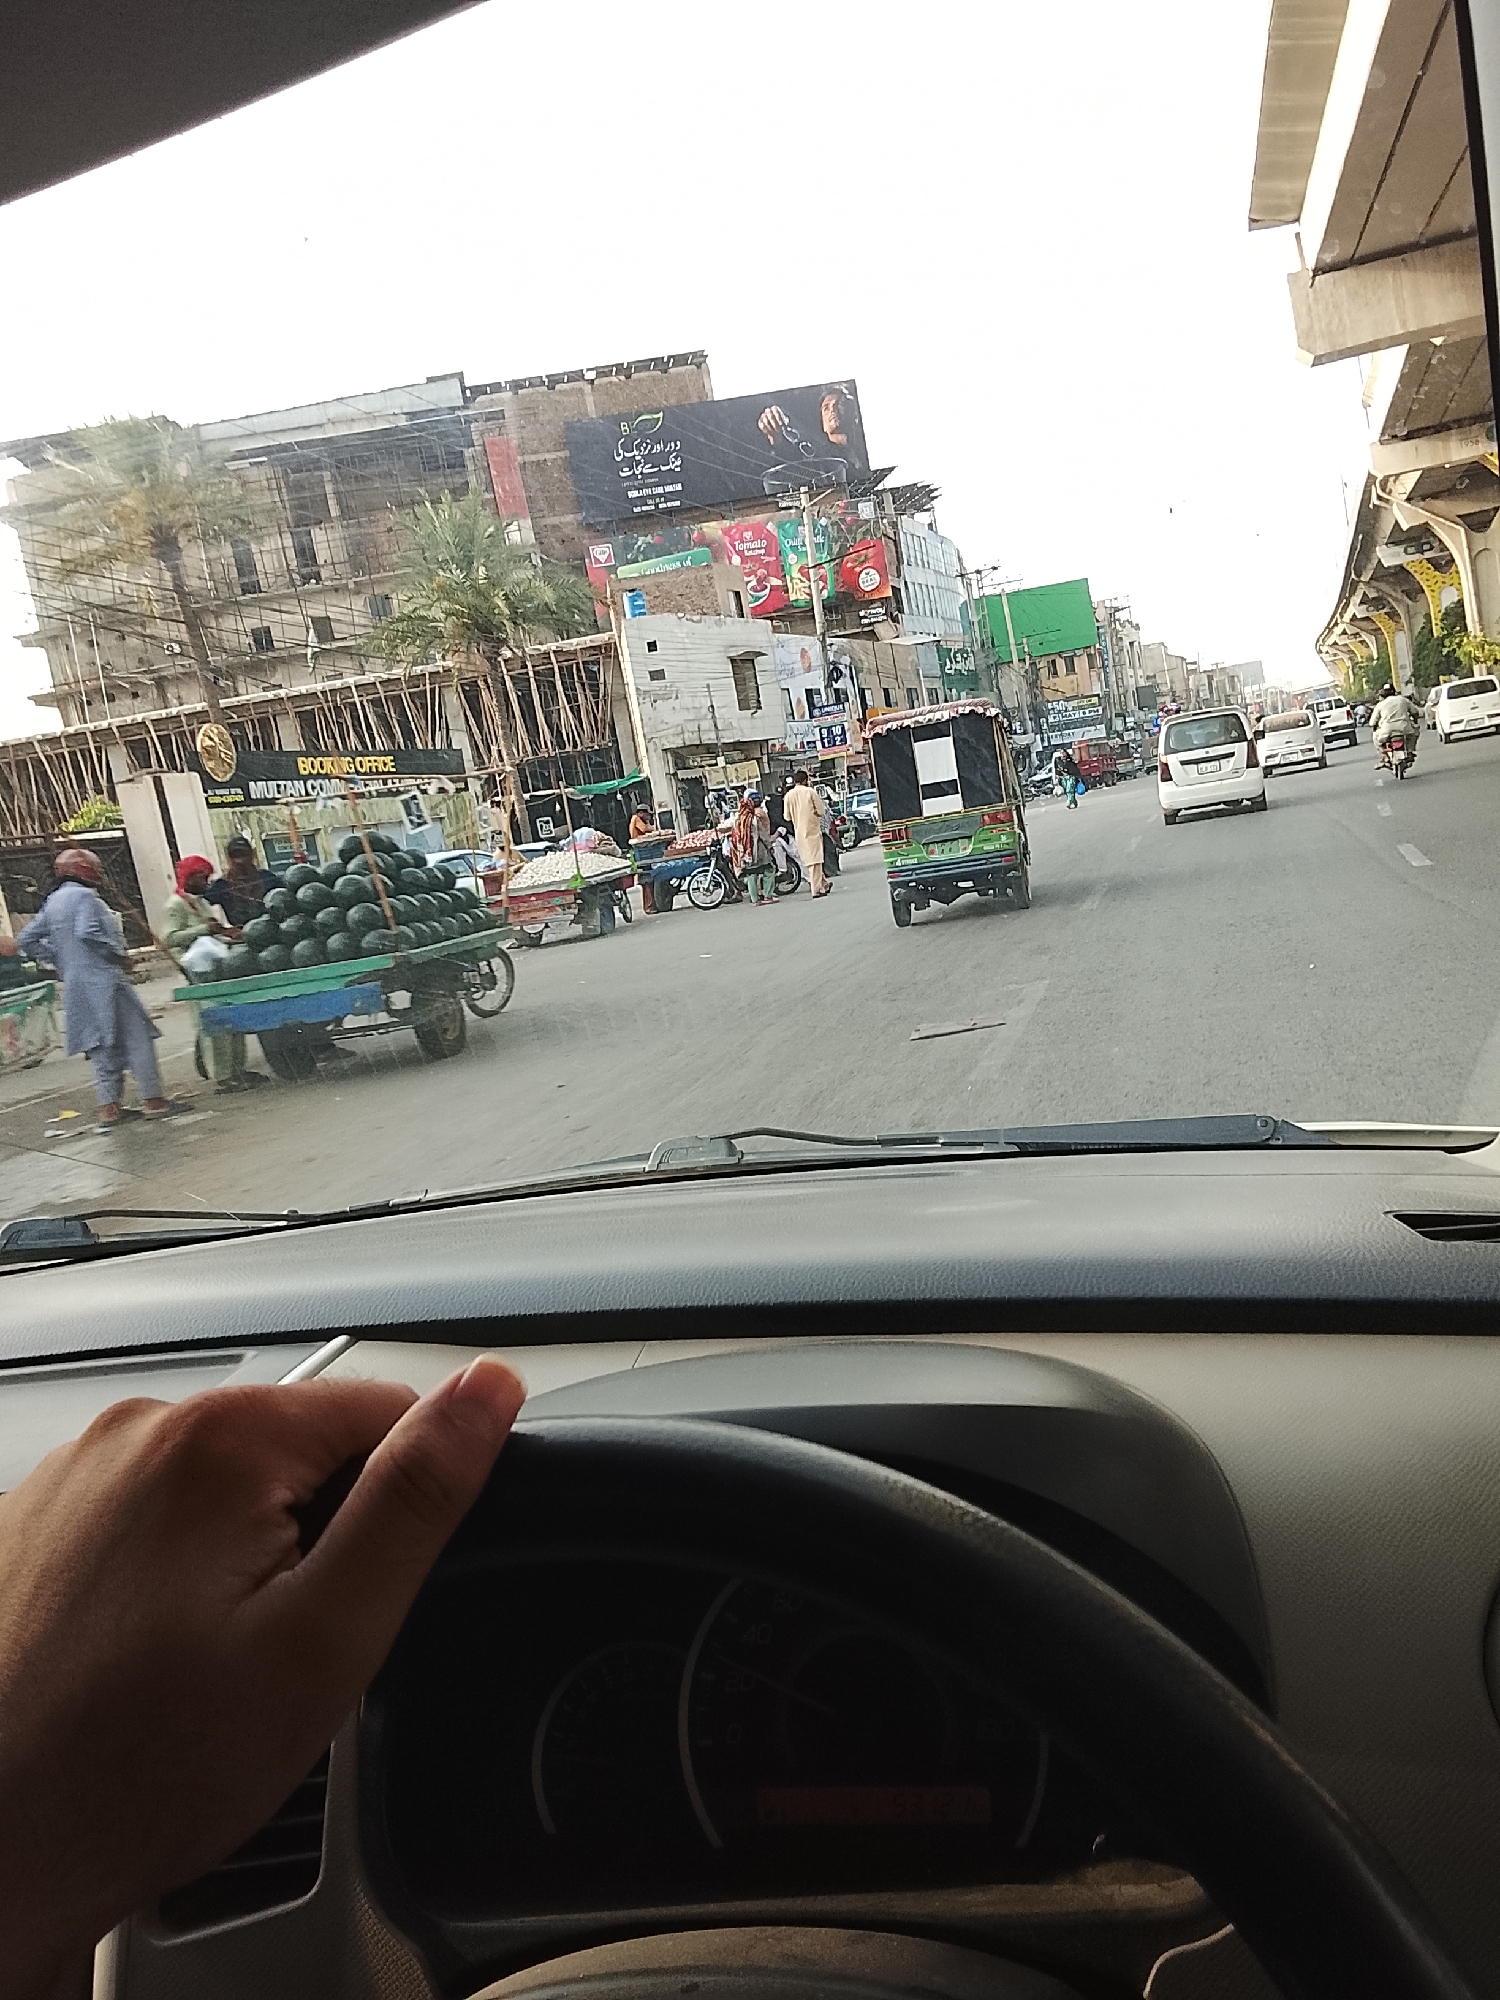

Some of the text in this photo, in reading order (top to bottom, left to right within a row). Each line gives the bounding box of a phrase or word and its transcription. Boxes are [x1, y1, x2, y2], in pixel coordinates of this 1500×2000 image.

[734, 540, 767, 551] Tomato
[297, 755, 396, 775] BOOKING OFFICE
[248, 780, 306, 799] MULTAN
